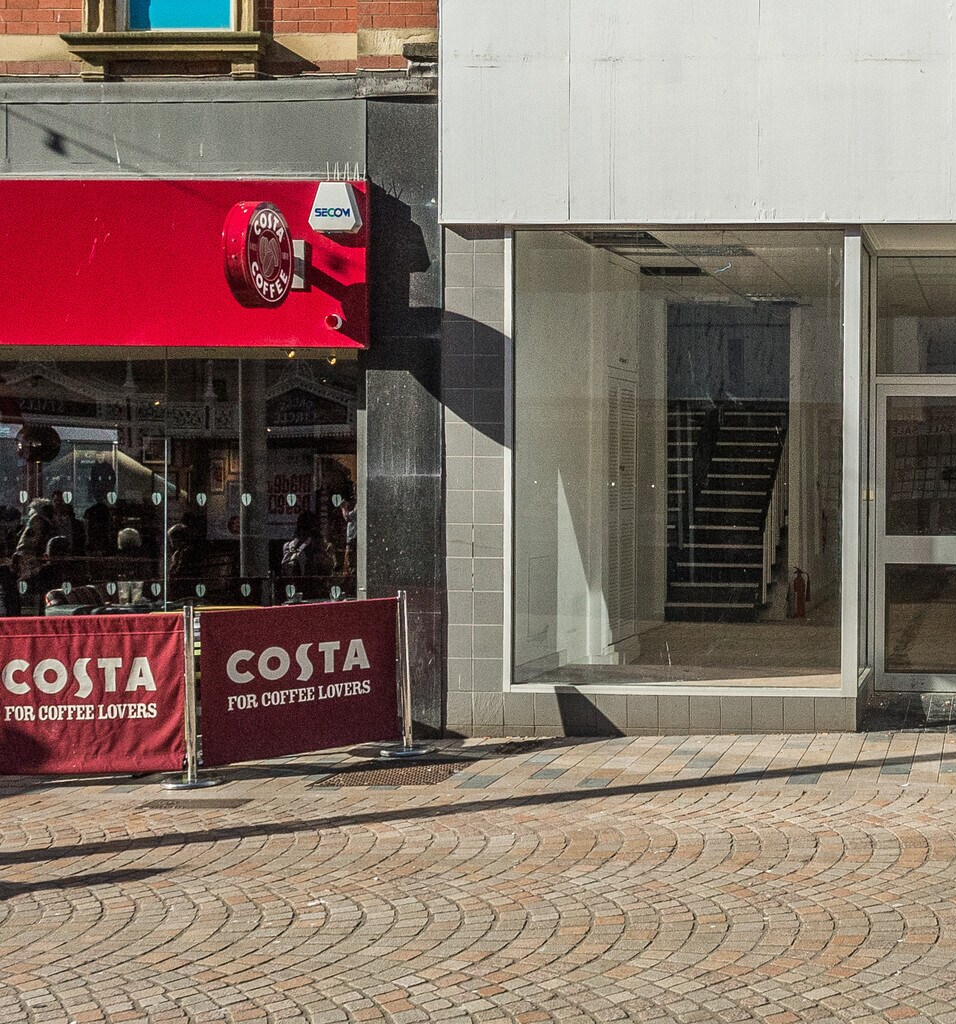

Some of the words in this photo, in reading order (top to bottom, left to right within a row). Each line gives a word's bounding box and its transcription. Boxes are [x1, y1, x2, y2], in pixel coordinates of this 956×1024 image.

[253, 213, 284, 243] COSTA
[314, 207, 351, 218] SECOM
[251, 261, 288, 299] COFFEE
[226, 638, 371, 684] COSTA
[1, 657, 157, 698] COSTA
[228, 695, 259, 711] FOR
[261, 688, 315, 707] COFFEE
[318, 680, 371, 699] LOVERS
[4, 706, 36, 722] FOR
[38, 705, 95, 721] COFFEE
[97, 703, 157, 720] LOVERS
